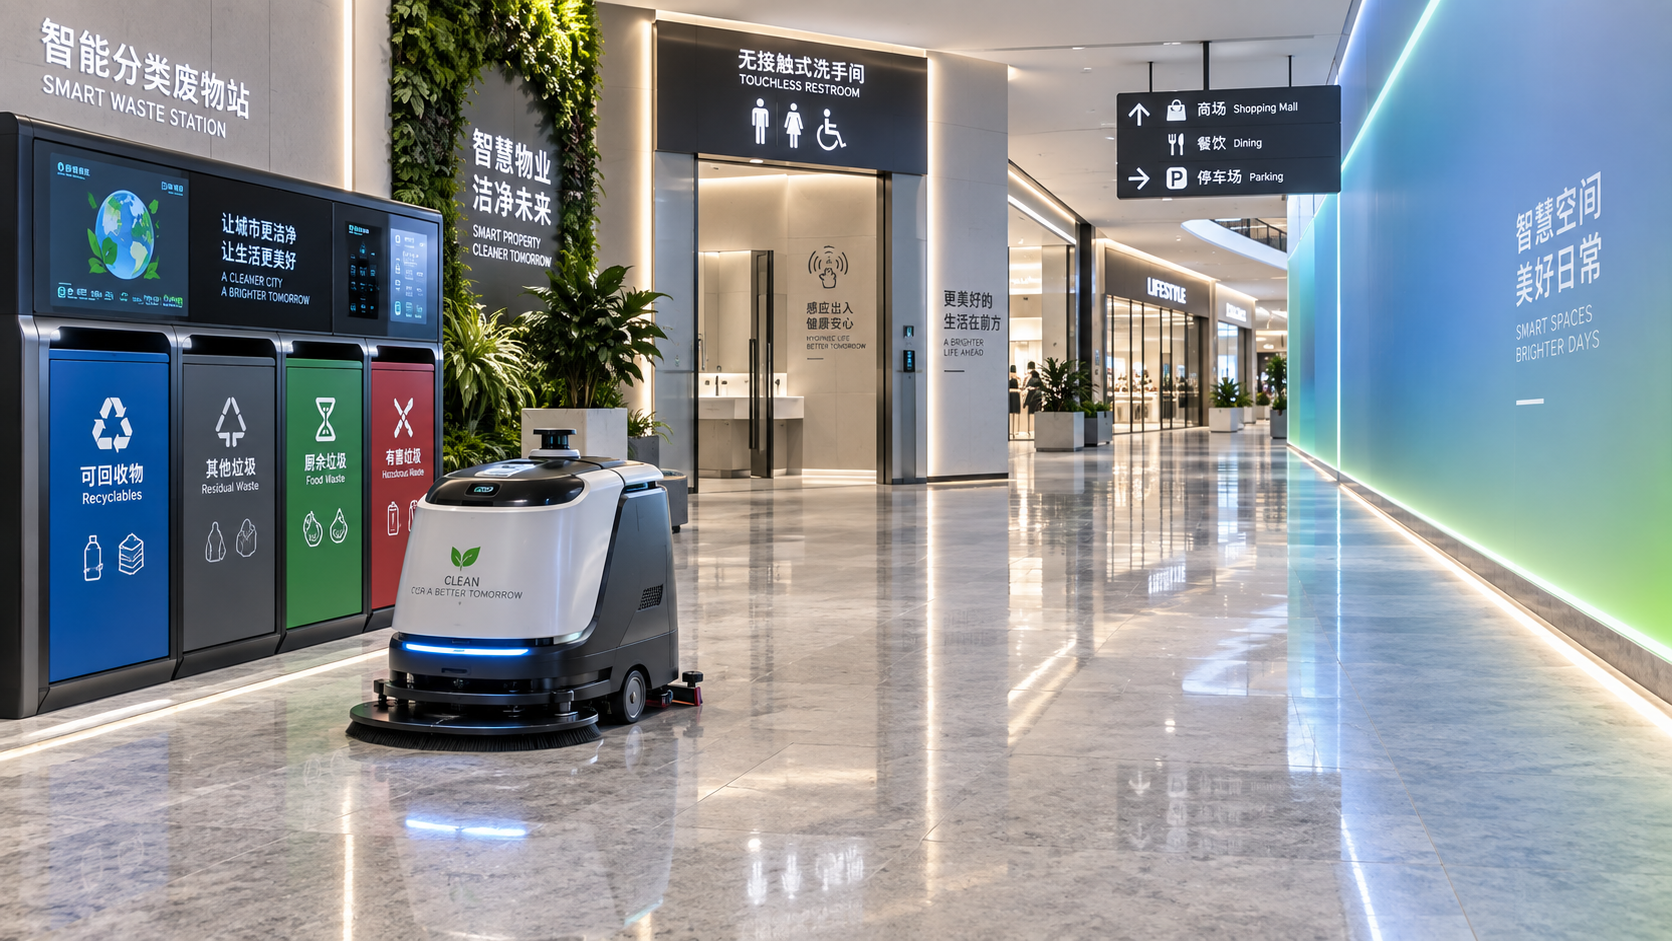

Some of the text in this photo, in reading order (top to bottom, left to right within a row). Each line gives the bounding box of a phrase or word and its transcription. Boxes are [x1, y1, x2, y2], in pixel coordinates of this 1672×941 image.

[41, 17, 250, 119] 智能分类废物站
[738, 49, 865, 84] 无接触式洗手间
[739, 73, 860, 98] TOUCHLESS RESTROOM
[42, 74, 226, 138] SMART WASTE STATION
[1197, 101, 1227, 117] 商场
[1233, 102, 1298, 115] Shopping Mall
[1197, 135, 1227, 151] 餐饮
[1233, 138, 1262, 149] Dining
[472, 128, 551, 185] 智慧物业
[1197, 169, 1242, 185] 停车场
[1249, 172, 1284, 183] Parking
[472, 174, 551, 226] 洁净未来
[1516, 171, 1602, 254] 智慧空间
[221, 212, 297, 245] 让城市更洁净
[472, 224, 541, 249] SMART PROPERTY
[221, 240, 297, 271] 让生活更美好
[1516, 232, 1602, 307] 美好日常
[221, 271, 228, 282] A
[265, 277, 283, 288] CITY
[221, 286, 310, 305] A BRIGHTER TOMORROW
[944, 290, 993, 309] 更美好的
[1147, 277, 1186, 304] LIFESTYLE
[944, 313, 1001, 331] 生活在前方
[1516, 304, 1593, 340] SMART SPACES
[943, 338, 949, 346] A
[1516, 329, 1600, 362] BRIGHTER DAYS
[943, 348, 958, 356] LIFE
[80, 463, 144, 487] 可回收物
[206, 457, 257, 479] 其他垃圾
[201, 481, 260, 495] Residual Waste
[306, 474, 346, 486] Food Waste
[82, 489, 142, 505] Recyclables
[444, 575, 480, 587] CLEAN
[435, 588, 466, 597] BETTER
[469, 590, 523, 600] TOMORROW
